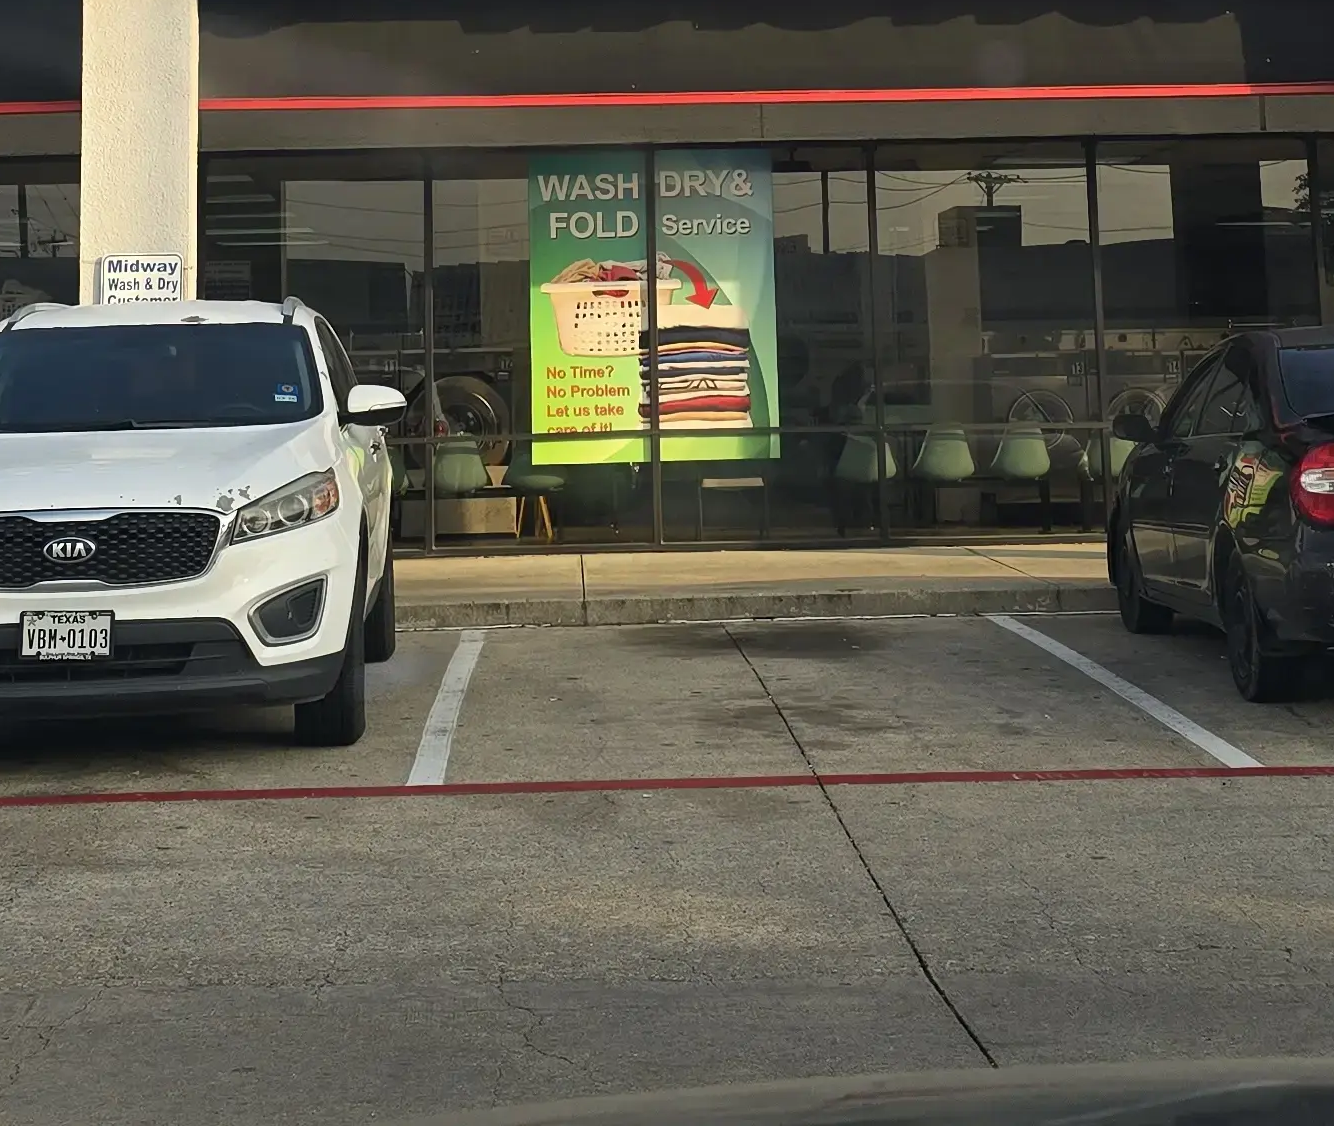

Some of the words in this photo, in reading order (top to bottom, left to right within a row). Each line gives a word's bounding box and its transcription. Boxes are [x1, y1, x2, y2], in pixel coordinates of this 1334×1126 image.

[537, 173, 639, 202] WASH
[660, 169, 754, 197] DRY&
[549, 210, 639, 239] FOLD
[662, 214, 751, 236] Service
[108, 260, 178, 275] Midway
[108, 277, 140, 291] Wash
[144, 277, 153, 290] &
[158, 277, 178, 293] Dry
[546, 366, 566, 379] No
[570, 365, 614, 378] Time?
[546, 385, 566, 398] No
[571, 384, 630, 398] Problem
[546, 404, 569, 417] Let
[573, 406, 590, 416] us
[595, 403, 624, 416] take
[582, 423, 596, 432] of
[52, 542, 87, 557] KIA
[51, 615, 85, 624] TEXAS
[27, 628, 58, 649] VBM
[67, 628, 108, 649] 0103
